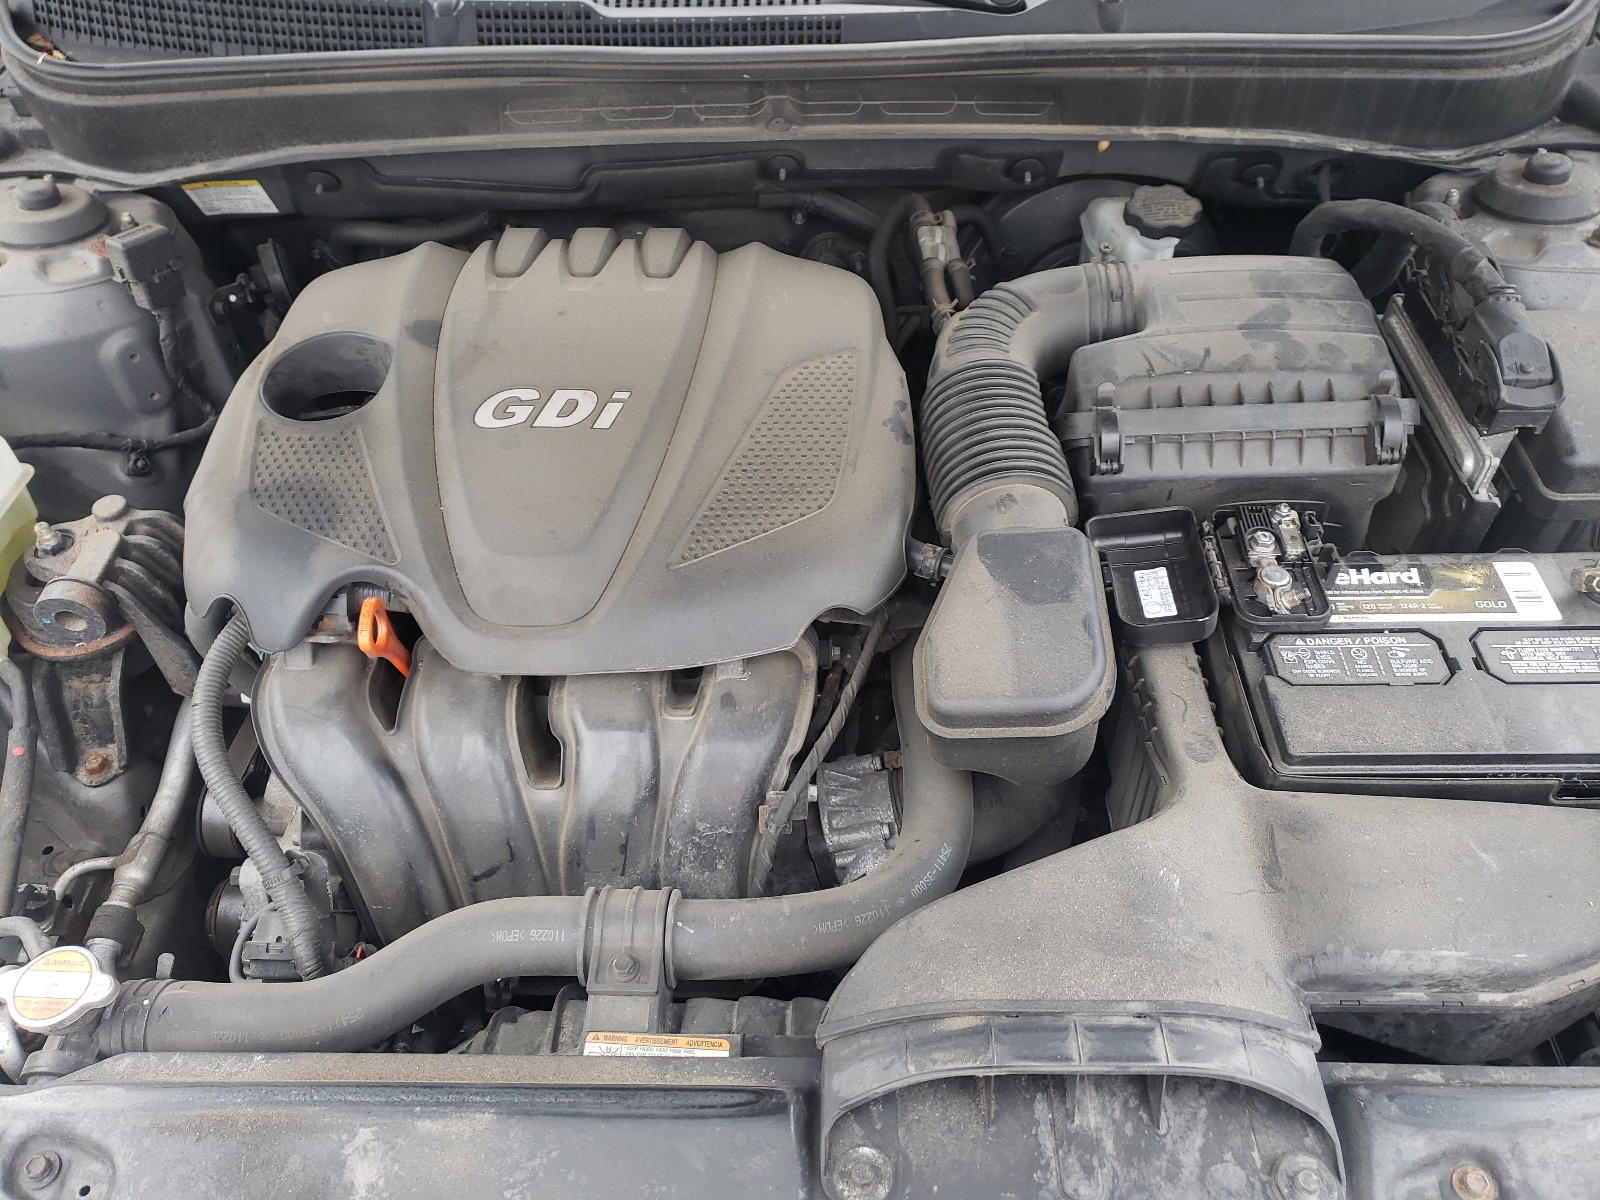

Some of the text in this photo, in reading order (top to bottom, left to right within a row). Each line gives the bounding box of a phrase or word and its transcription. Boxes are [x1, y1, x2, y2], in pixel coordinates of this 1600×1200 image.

[473, 387, 633, 430] GDi
[1335, 567, 1421, 585] eHard
[1475, 600, 1507, 608] GOLD
[1306, 637, 1352, 646] DANGER
[1363, 636, 1407, 645] POISON
[530, 929, 565, 942] 110226
[603, 1034, 723, 1048] WARNING AVERTISSEMENT ADVERTENCIA
